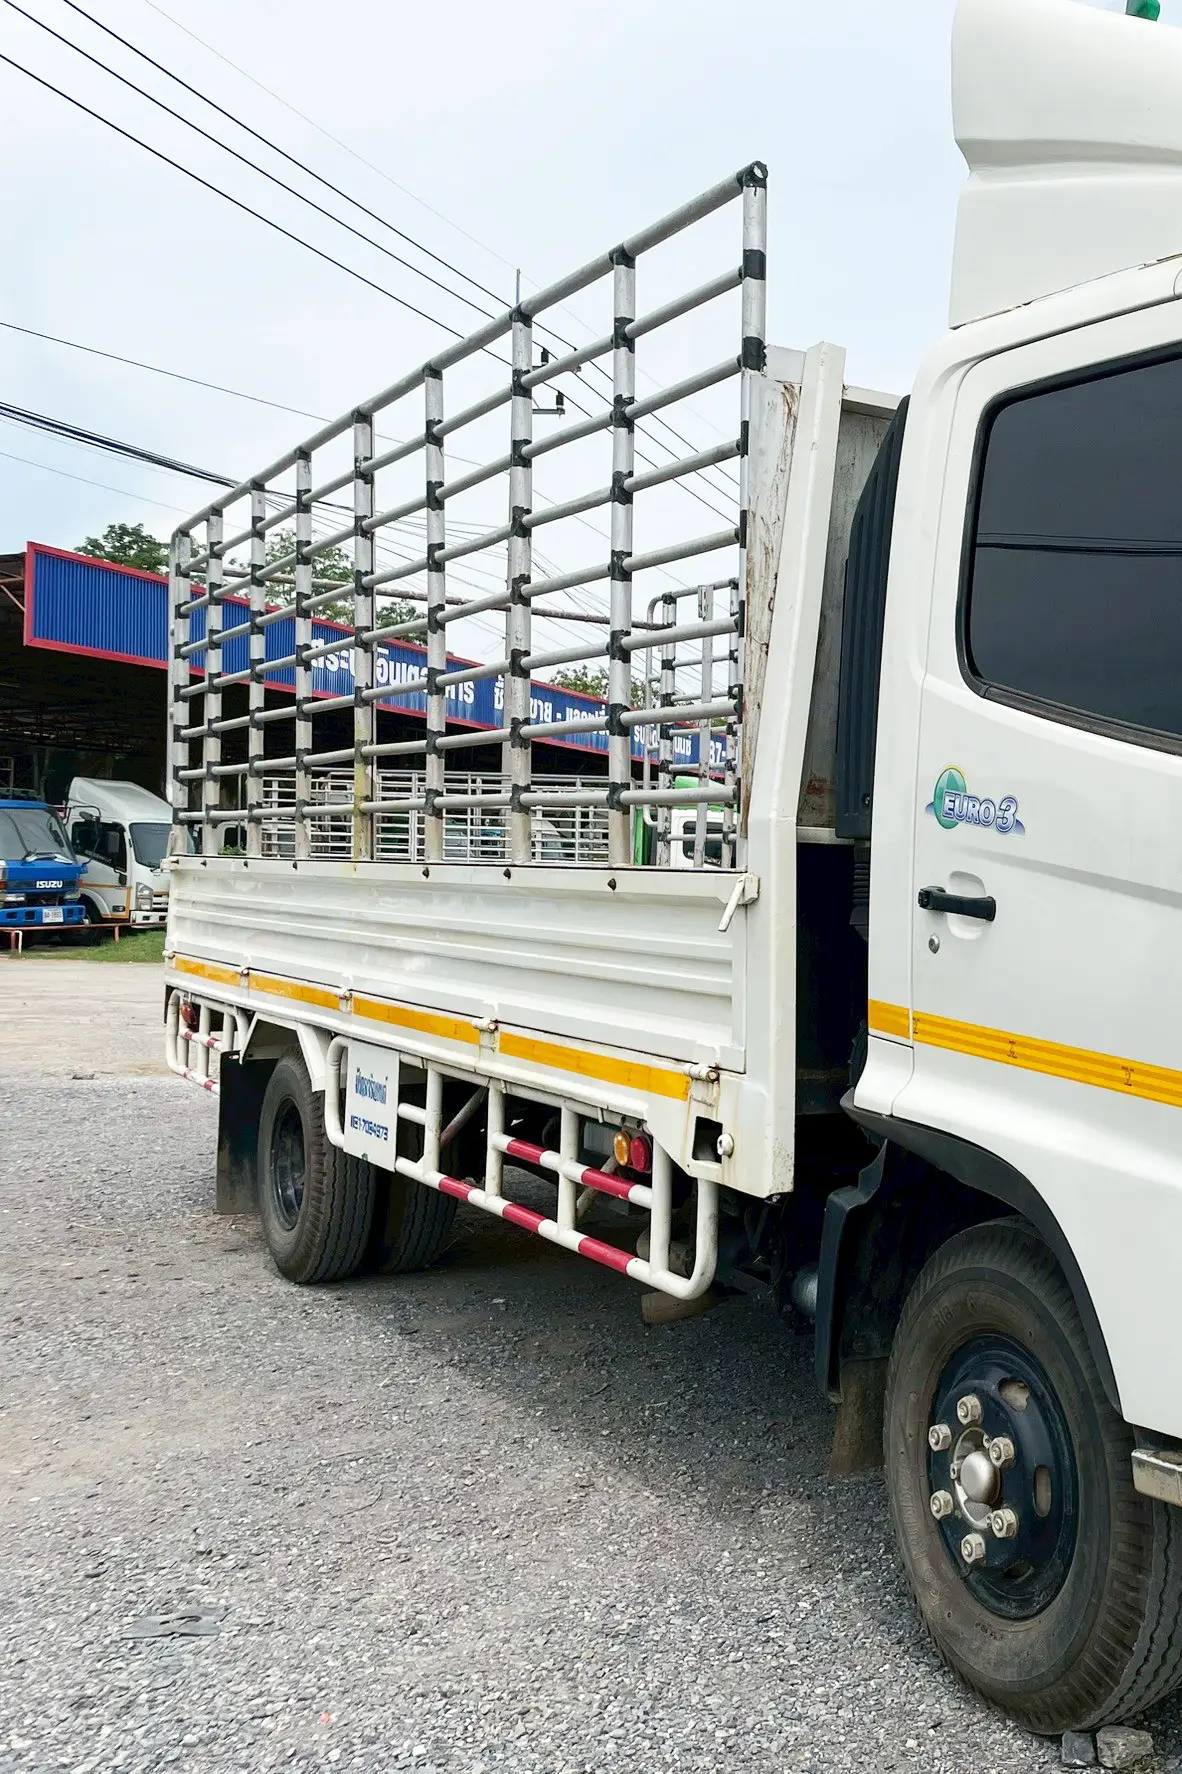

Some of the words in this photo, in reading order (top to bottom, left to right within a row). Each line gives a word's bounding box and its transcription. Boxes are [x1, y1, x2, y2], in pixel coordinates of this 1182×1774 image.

[942, 790, 995, 827] EURO
[995, 796, 1018, 834] 3
[36, 880, 63, 889] ISUZU
